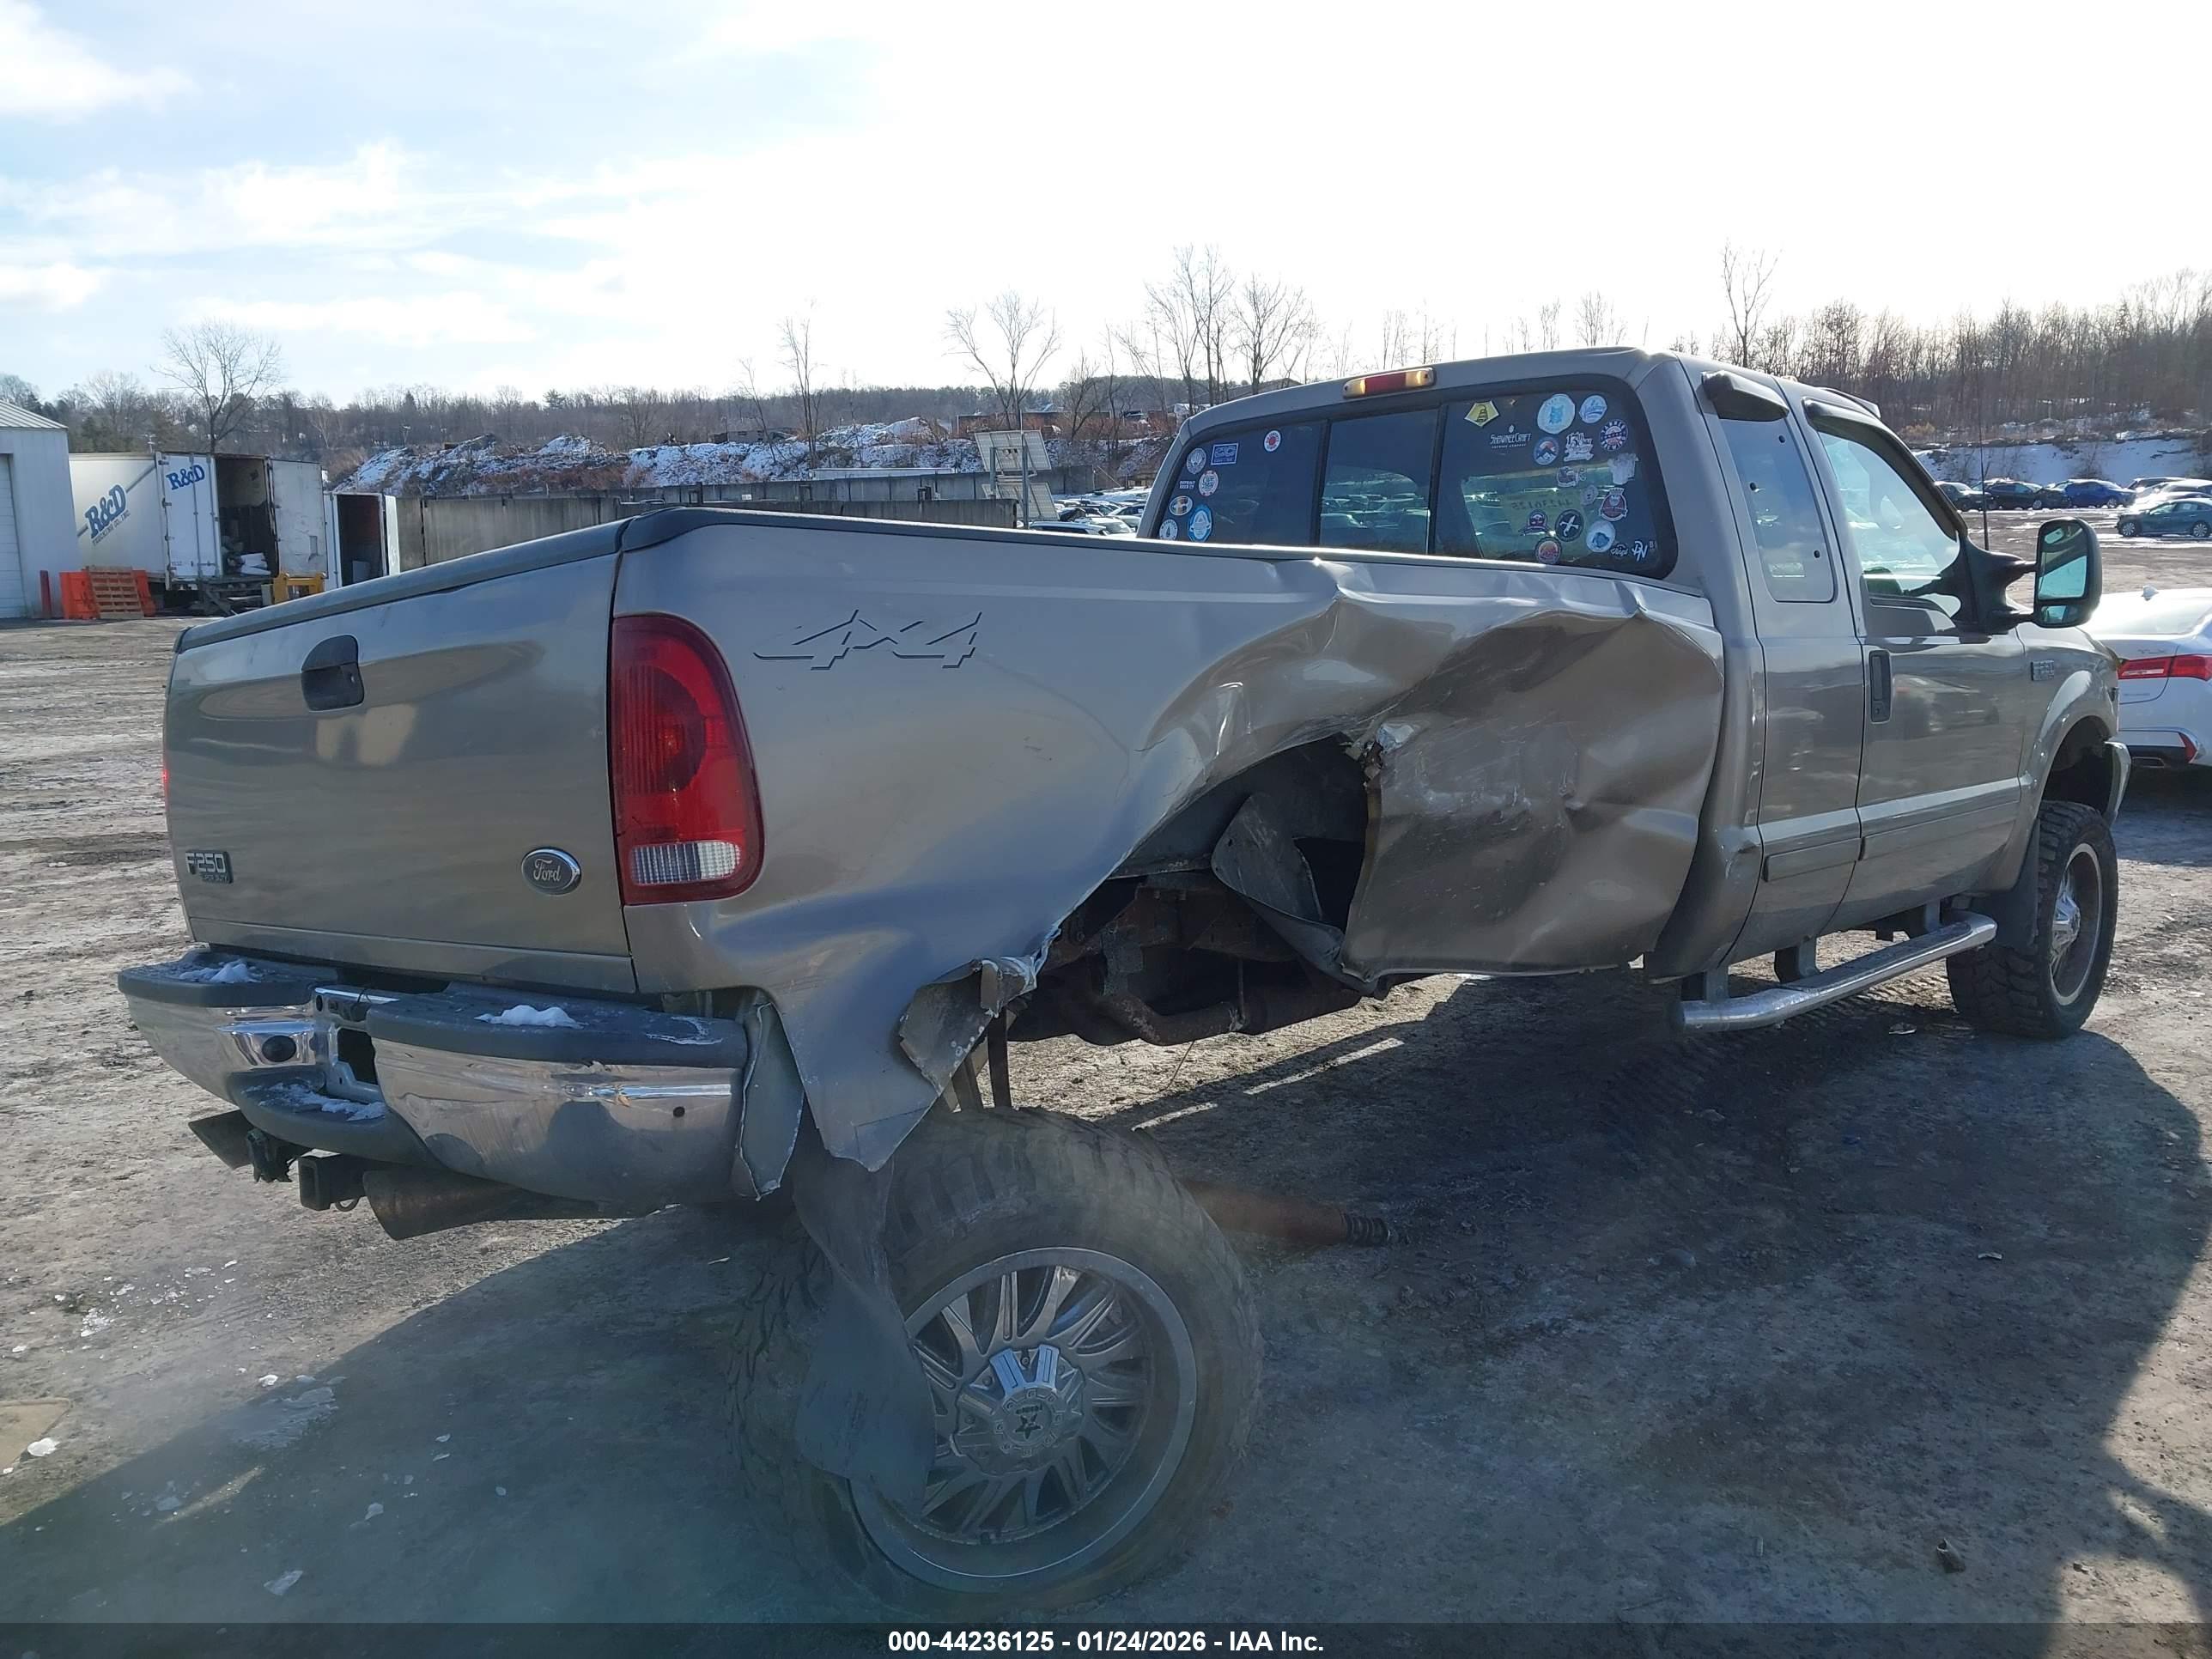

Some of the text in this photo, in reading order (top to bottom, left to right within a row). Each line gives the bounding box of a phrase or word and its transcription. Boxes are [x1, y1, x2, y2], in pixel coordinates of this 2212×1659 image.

[166, 465, 205, 490] R&D
[85, 484, 126, 539] R&D
[533, 859, 562, 882] Ford
